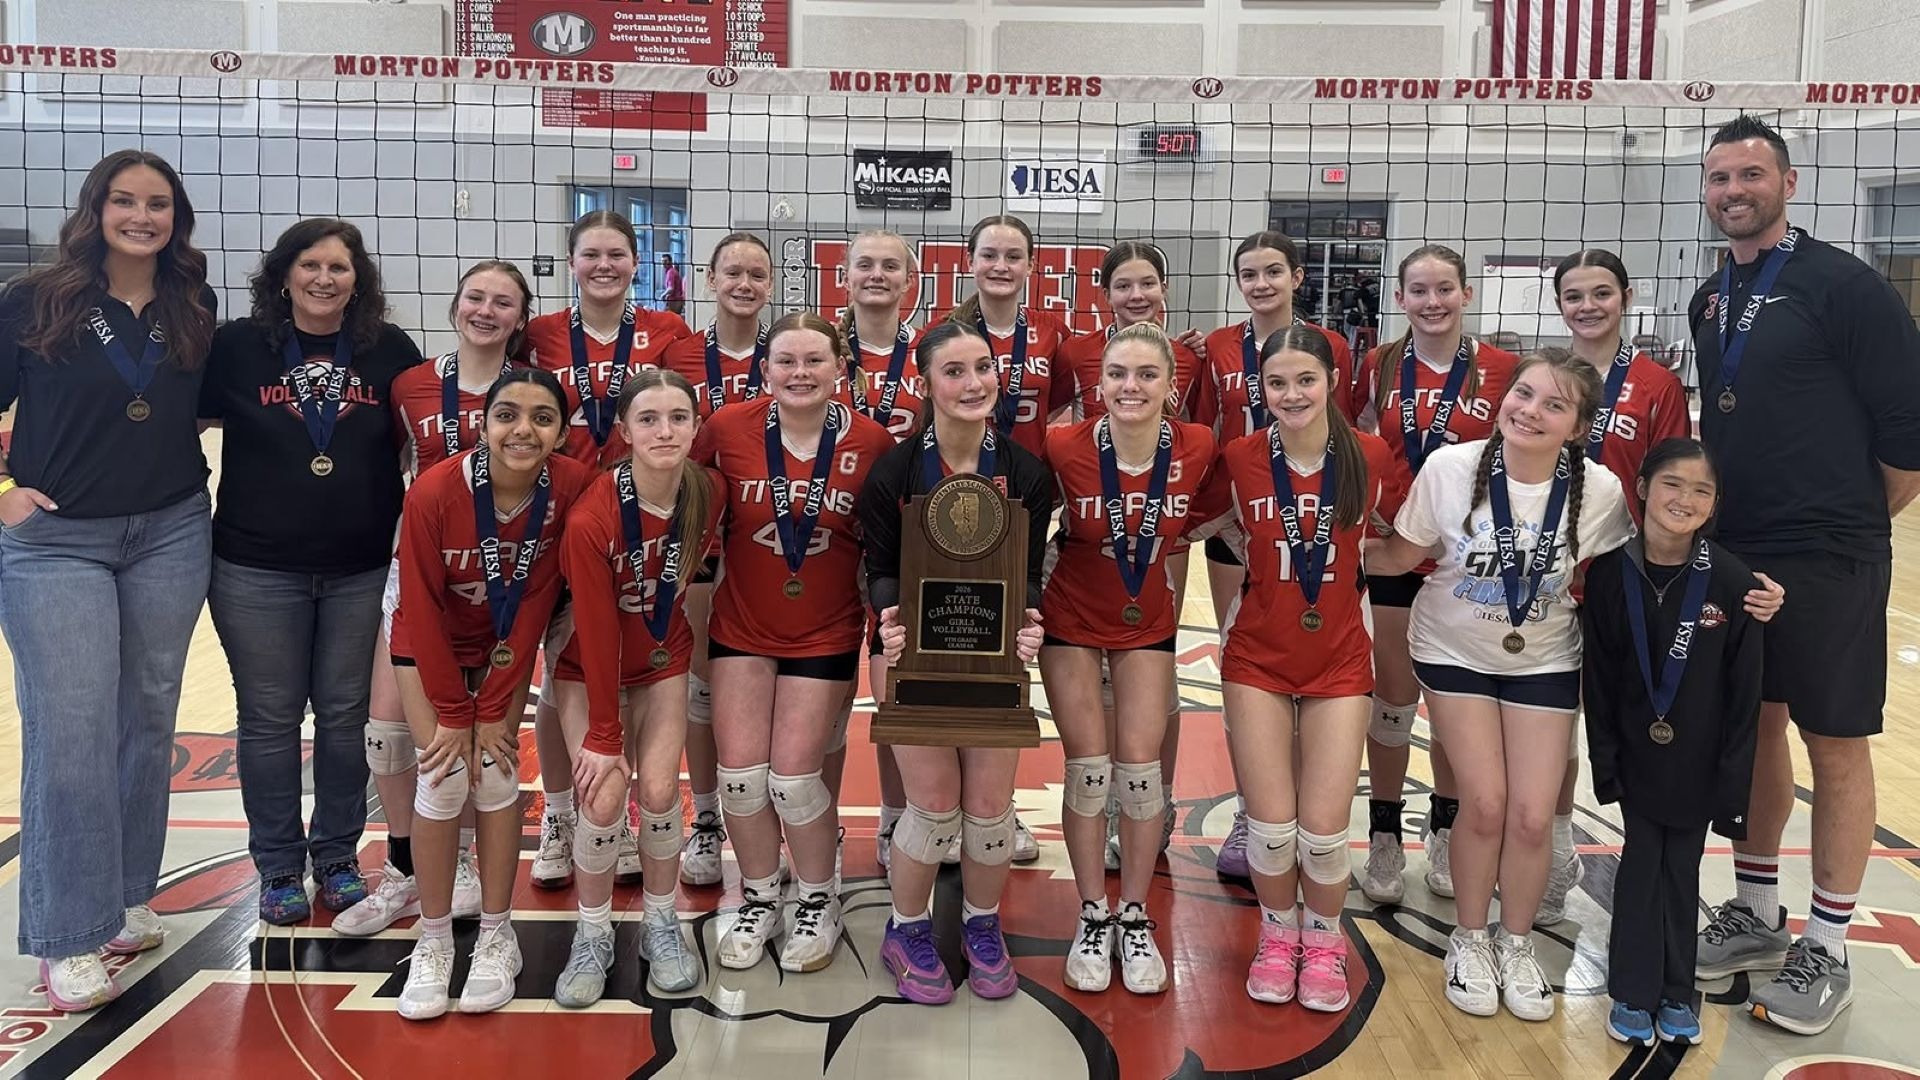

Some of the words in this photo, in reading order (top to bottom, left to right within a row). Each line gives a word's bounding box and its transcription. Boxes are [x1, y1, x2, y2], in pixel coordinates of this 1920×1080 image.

[470, 13, 493, 22] EVANS
[612, 23, 682, 34] sportsmanship
[684, 25, 693, 33] is
[695, 25, 709, 33] far
[614, 11, 633, 20] One
[636, 13, 656, 21] man
[658, 14, 707, 24] practicing
[540, 14, 586, 54] M
[609, 33, 638, 42] better
[640, 33, 662, 43] than
[671, 35, 711, 44] hundred
[634, 45, 675, 55] teaching
[677, 46, 687, 54] it.
[334, 55, 460, 79] MORTON
[474, 59, 615, 84] POTTERS
[829, 70, 953, 94] MORTON
[966, 73, 1102, 97] POTTERS
[1314, 77, 1441, 100] MORTON
[1453, 78, 1594, 101] POTTERS
[1157, 134, 1197, 152] 5:07
[1030, 167, 1102, 194] IESA
[1740, 294, 1765, 326] IESA
[91, 316, 115, 345] IESA
[633, 331, 650, 350] G
[839, 451, 859, 475] G
[740, 479, 855, 516] TIANS
[773, 487, 790, 517] IESA
[807, 478, 826, 510] IESA
[1076, 492, 1190, 519] TIANS
[1110, 509, 1125, 541] IESA
[1143, 499, 1161, 529] IESA
[1317, 505, 1334, 537] IESA
[1284, 515, 1302, 547] IESA
[517, 539, 537, 572] IESA
[664, 541, 681, 574] IESA
[1499, 537, 1516, 570] IESA
[1537, 530, 1554, 562] IESA
[483, 547, 501, 581] IESA
[928, 605, 997, 621] CHAMPIONS
[944, 594, 981, 605] STATE
[932, 626, 992, 635] VOLLEYBALL
[1482, 612, 1510, 624] IESA
[1674, 620, 1695, 652] IESA
